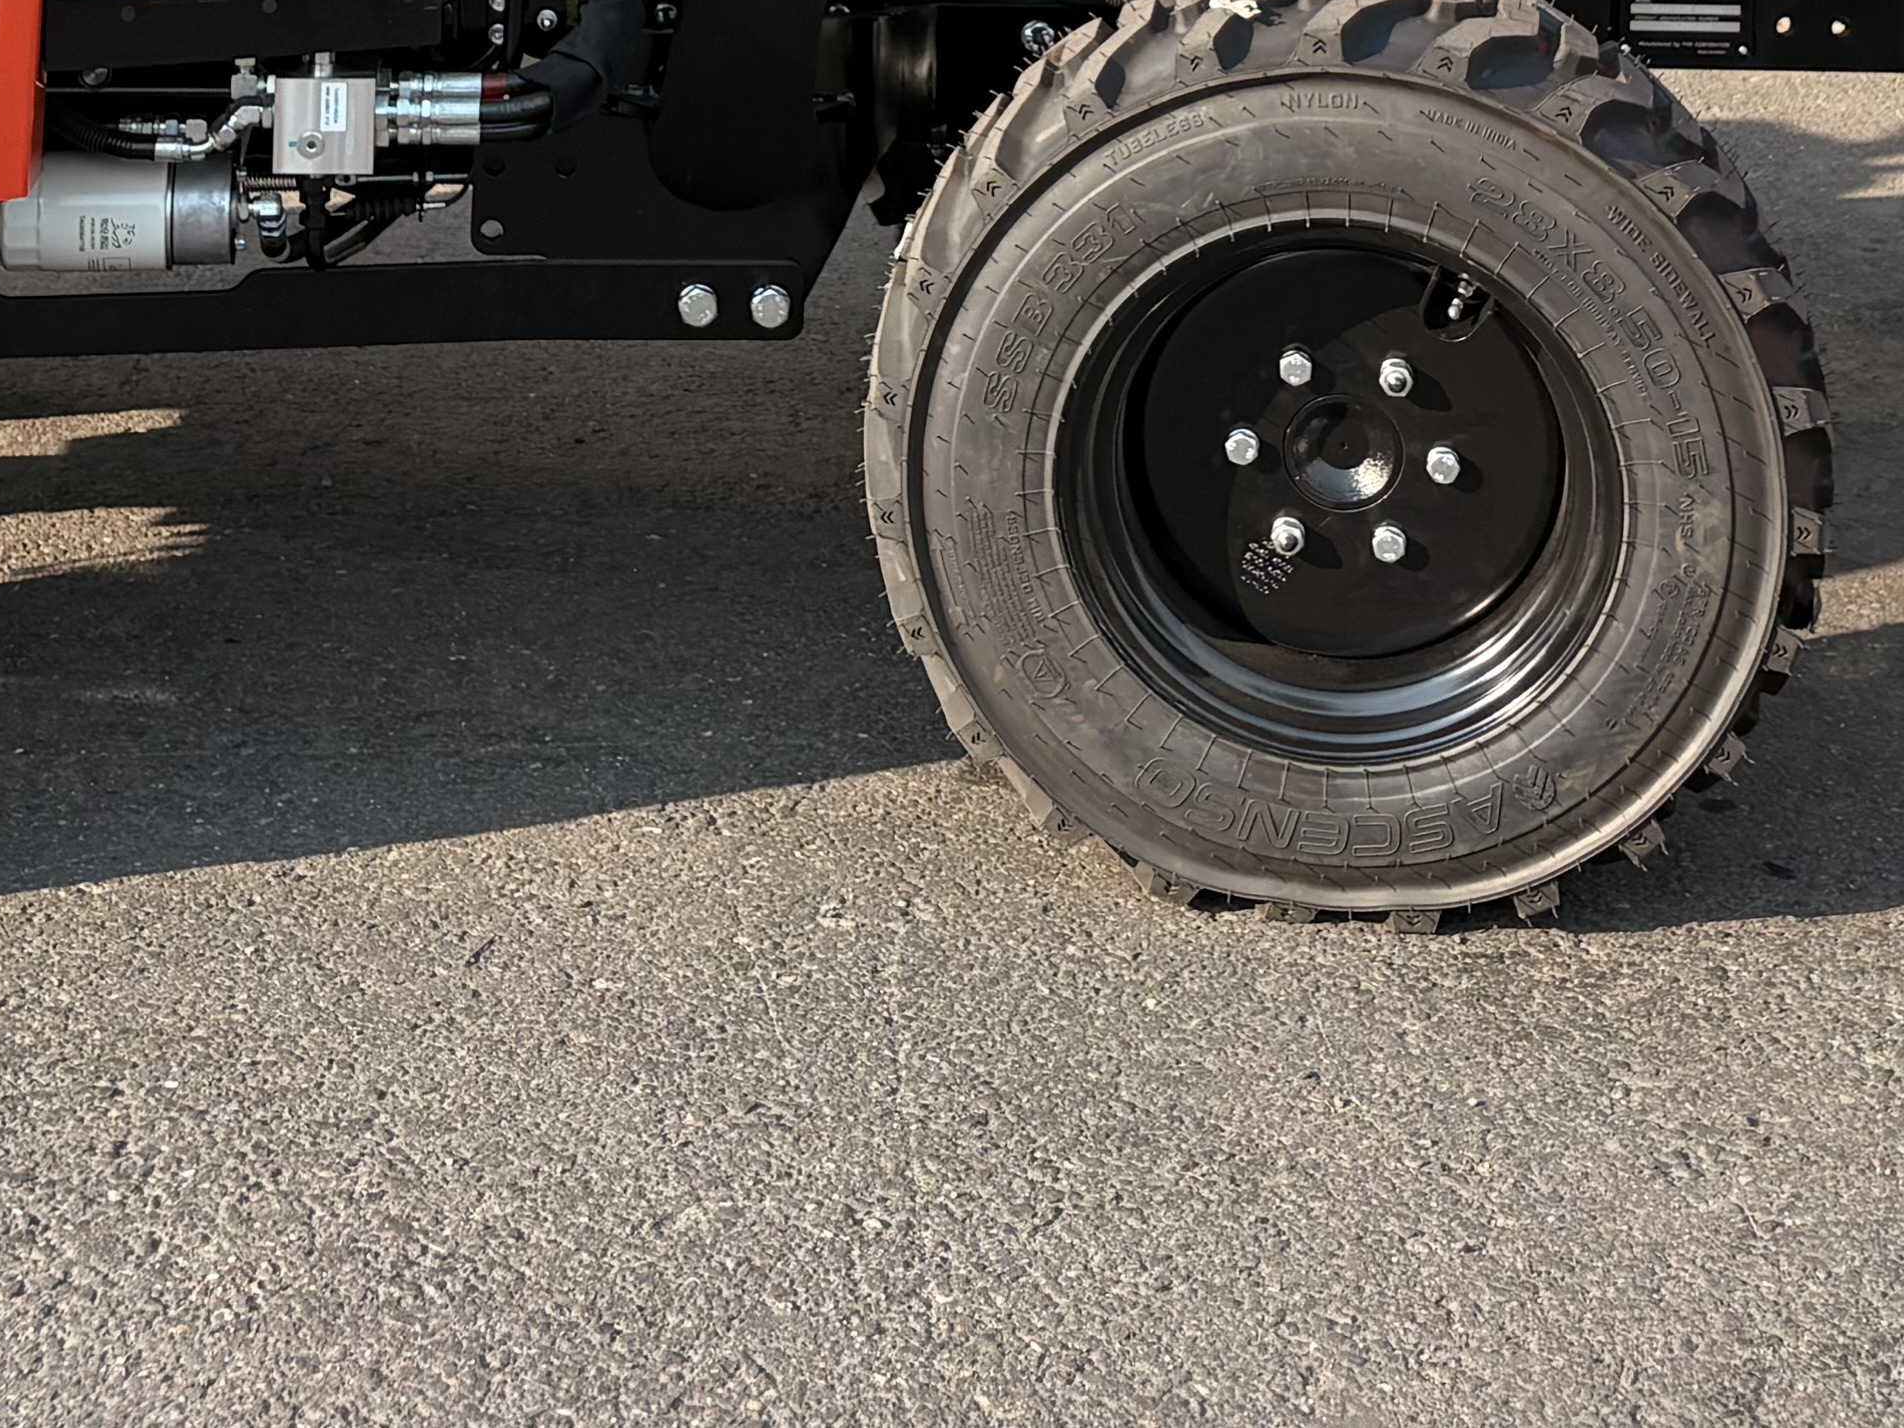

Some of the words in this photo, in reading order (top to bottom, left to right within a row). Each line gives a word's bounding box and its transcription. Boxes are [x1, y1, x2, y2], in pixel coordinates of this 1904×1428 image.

[1100, 109, 1203, 169] TUBELESS
[1282, 92, 1357, 112] NYLON
[973, 292, 1055, 415] SSB
[1036, 201, 1138, 297] 331
[1603, 201, 1652, 248] WIDE
[1646, 248, 1717, 345] SIDEWALL
[1465, 169, 1707, 475] 28X8.50-15
[1677, 492, 1696, 538] NHS
[1122, 756, 1522, 860] ASCENSO
